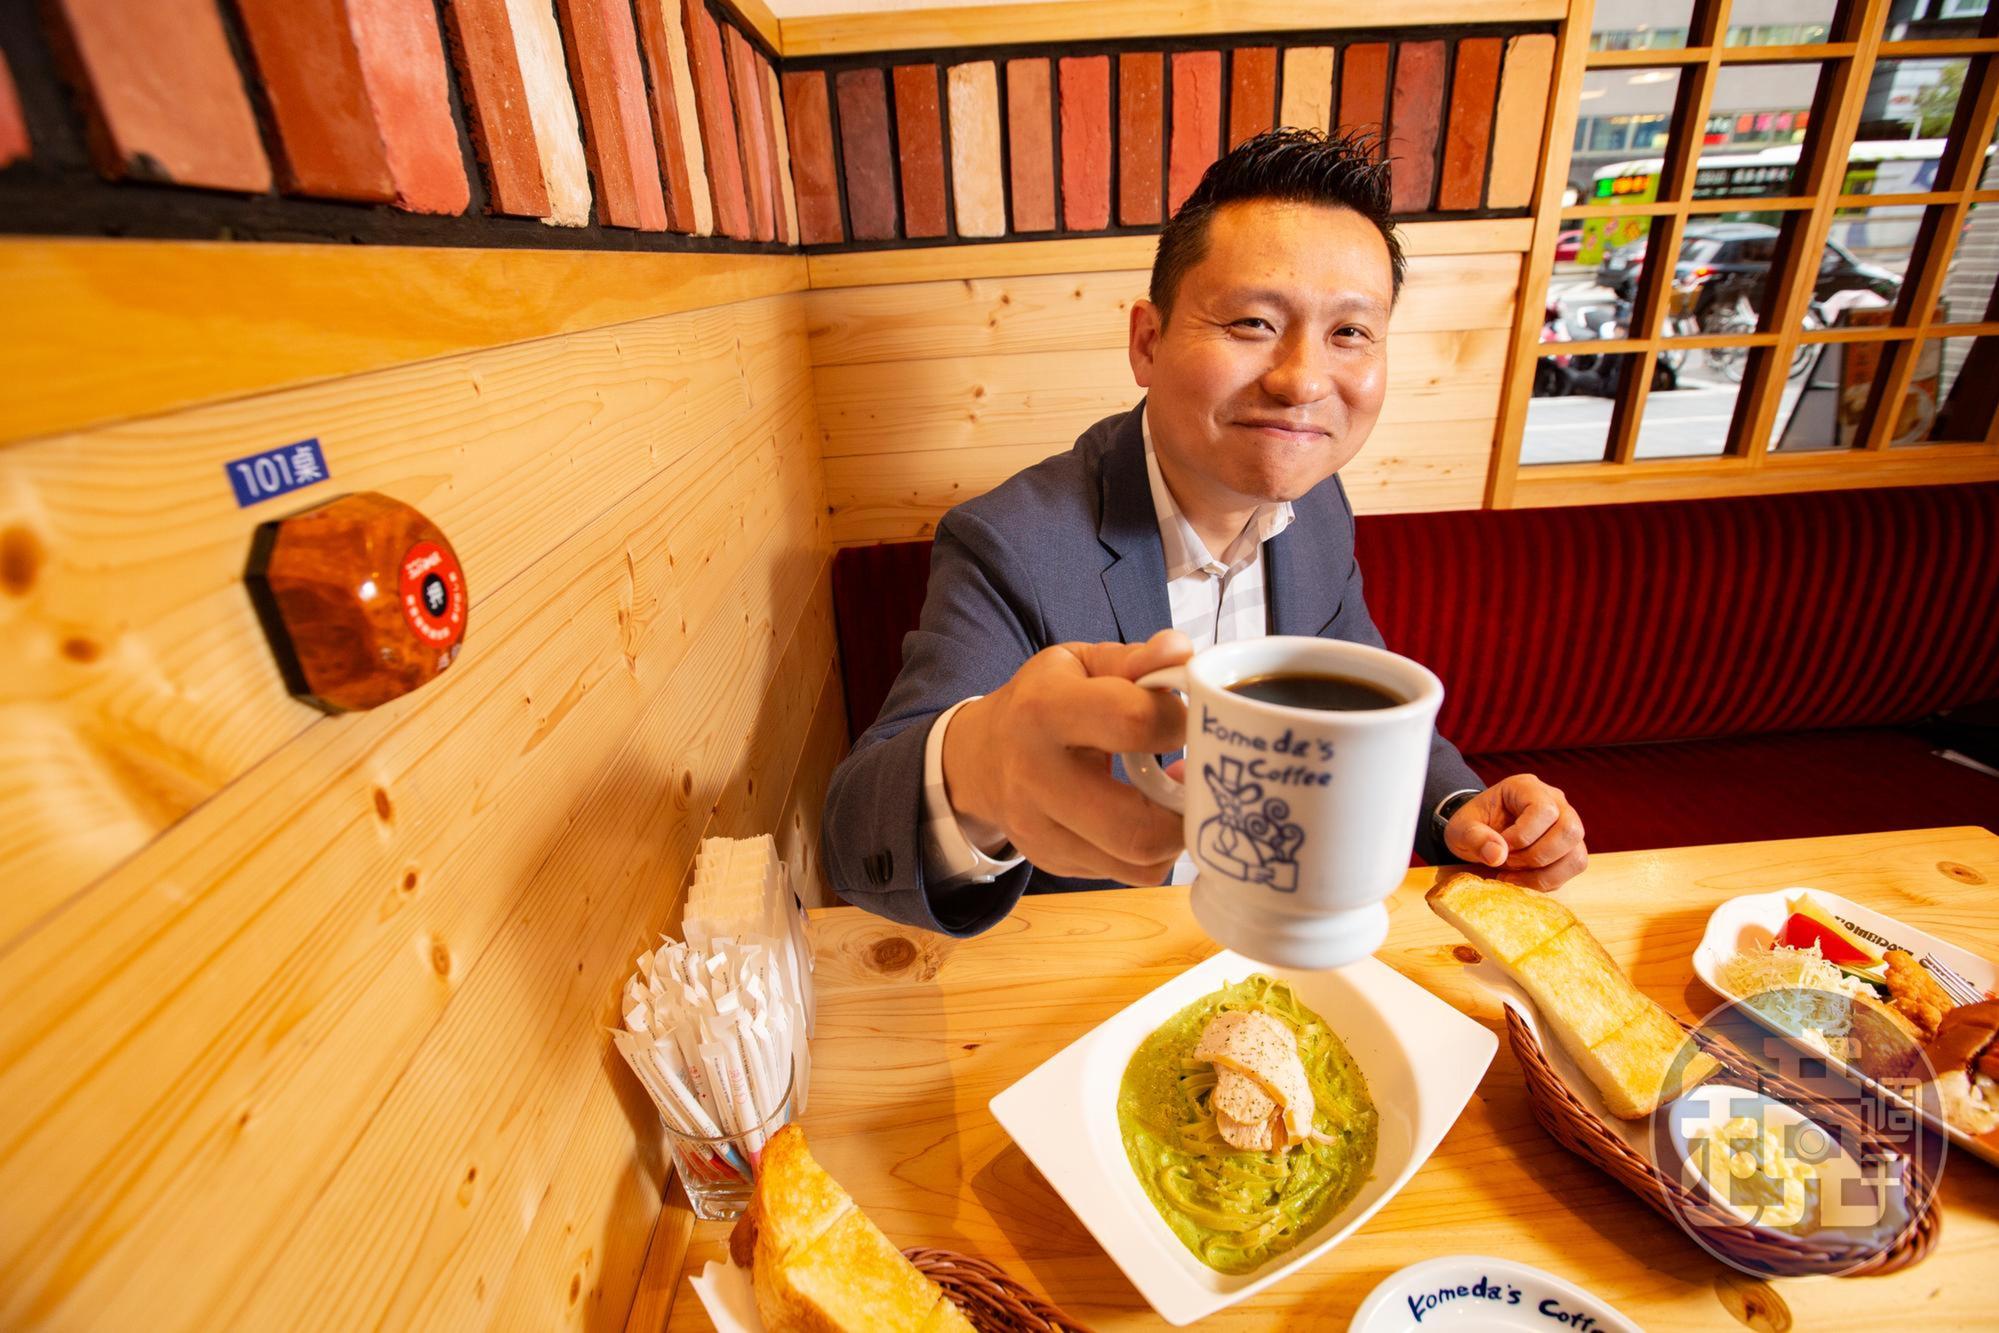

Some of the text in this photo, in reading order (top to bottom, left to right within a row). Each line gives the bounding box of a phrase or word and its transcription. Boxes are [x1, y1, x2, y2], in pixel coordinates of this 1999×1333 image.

[236, 446, 322, 497] 101桌
[1202, 704, 1335, 761] Komeda's
[1247, 757, 1333, 787] Coffee
[1407, 1275, 1605, 1333] Komeda's Coff
